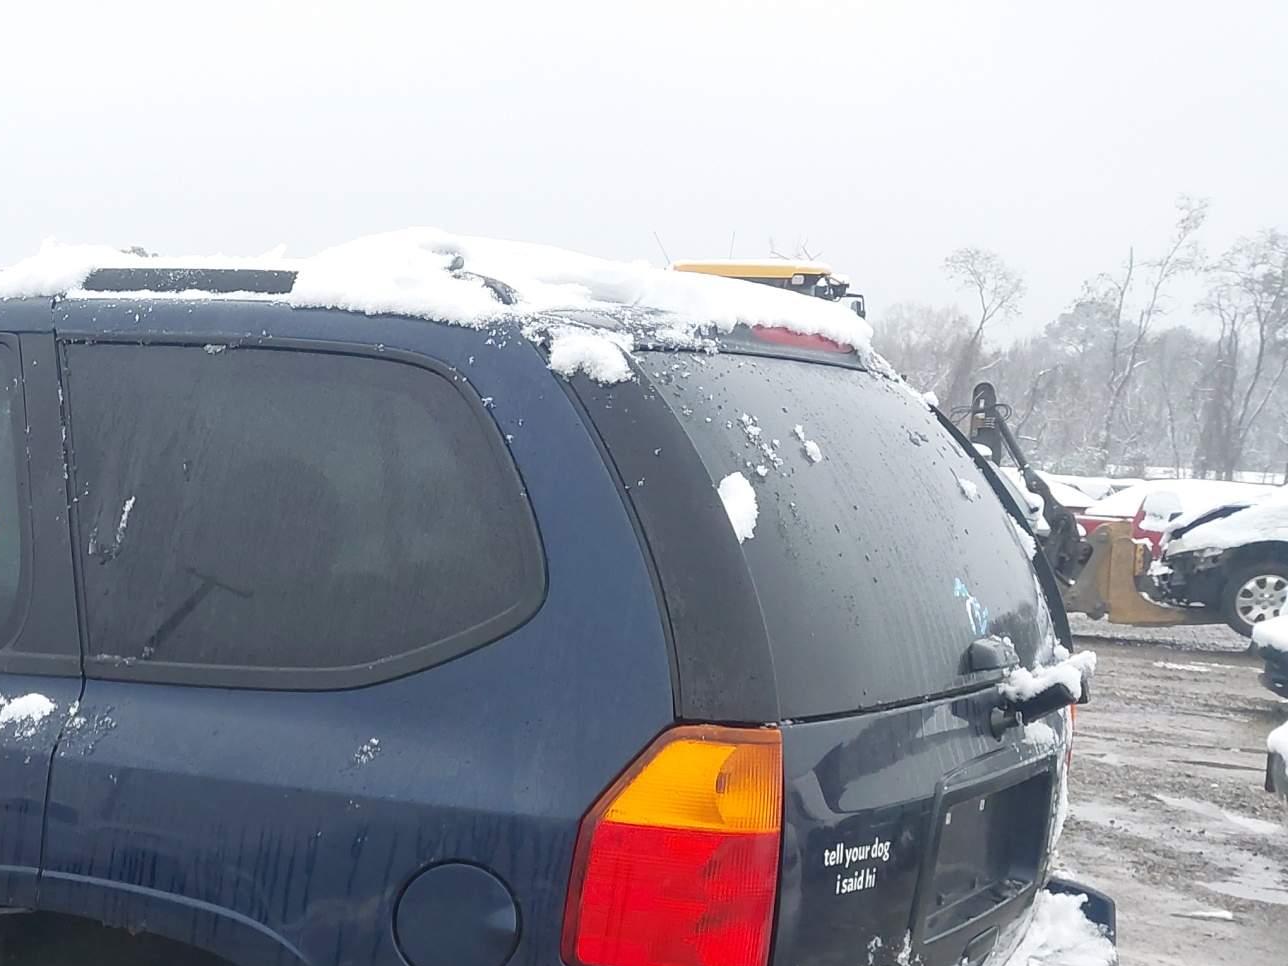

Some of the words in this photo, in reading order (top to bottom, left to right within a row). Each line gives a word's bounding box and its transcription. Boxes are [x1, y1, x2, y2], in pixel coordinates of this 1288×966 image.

[824, 842, 844, 867] tell
[845, 845, 870, 868] your
[871, 837, 890, 861] dog
[836, 874, 841, 894] i
[841, 869, 864, 893] said
[865, 867, 876, 888] hi
